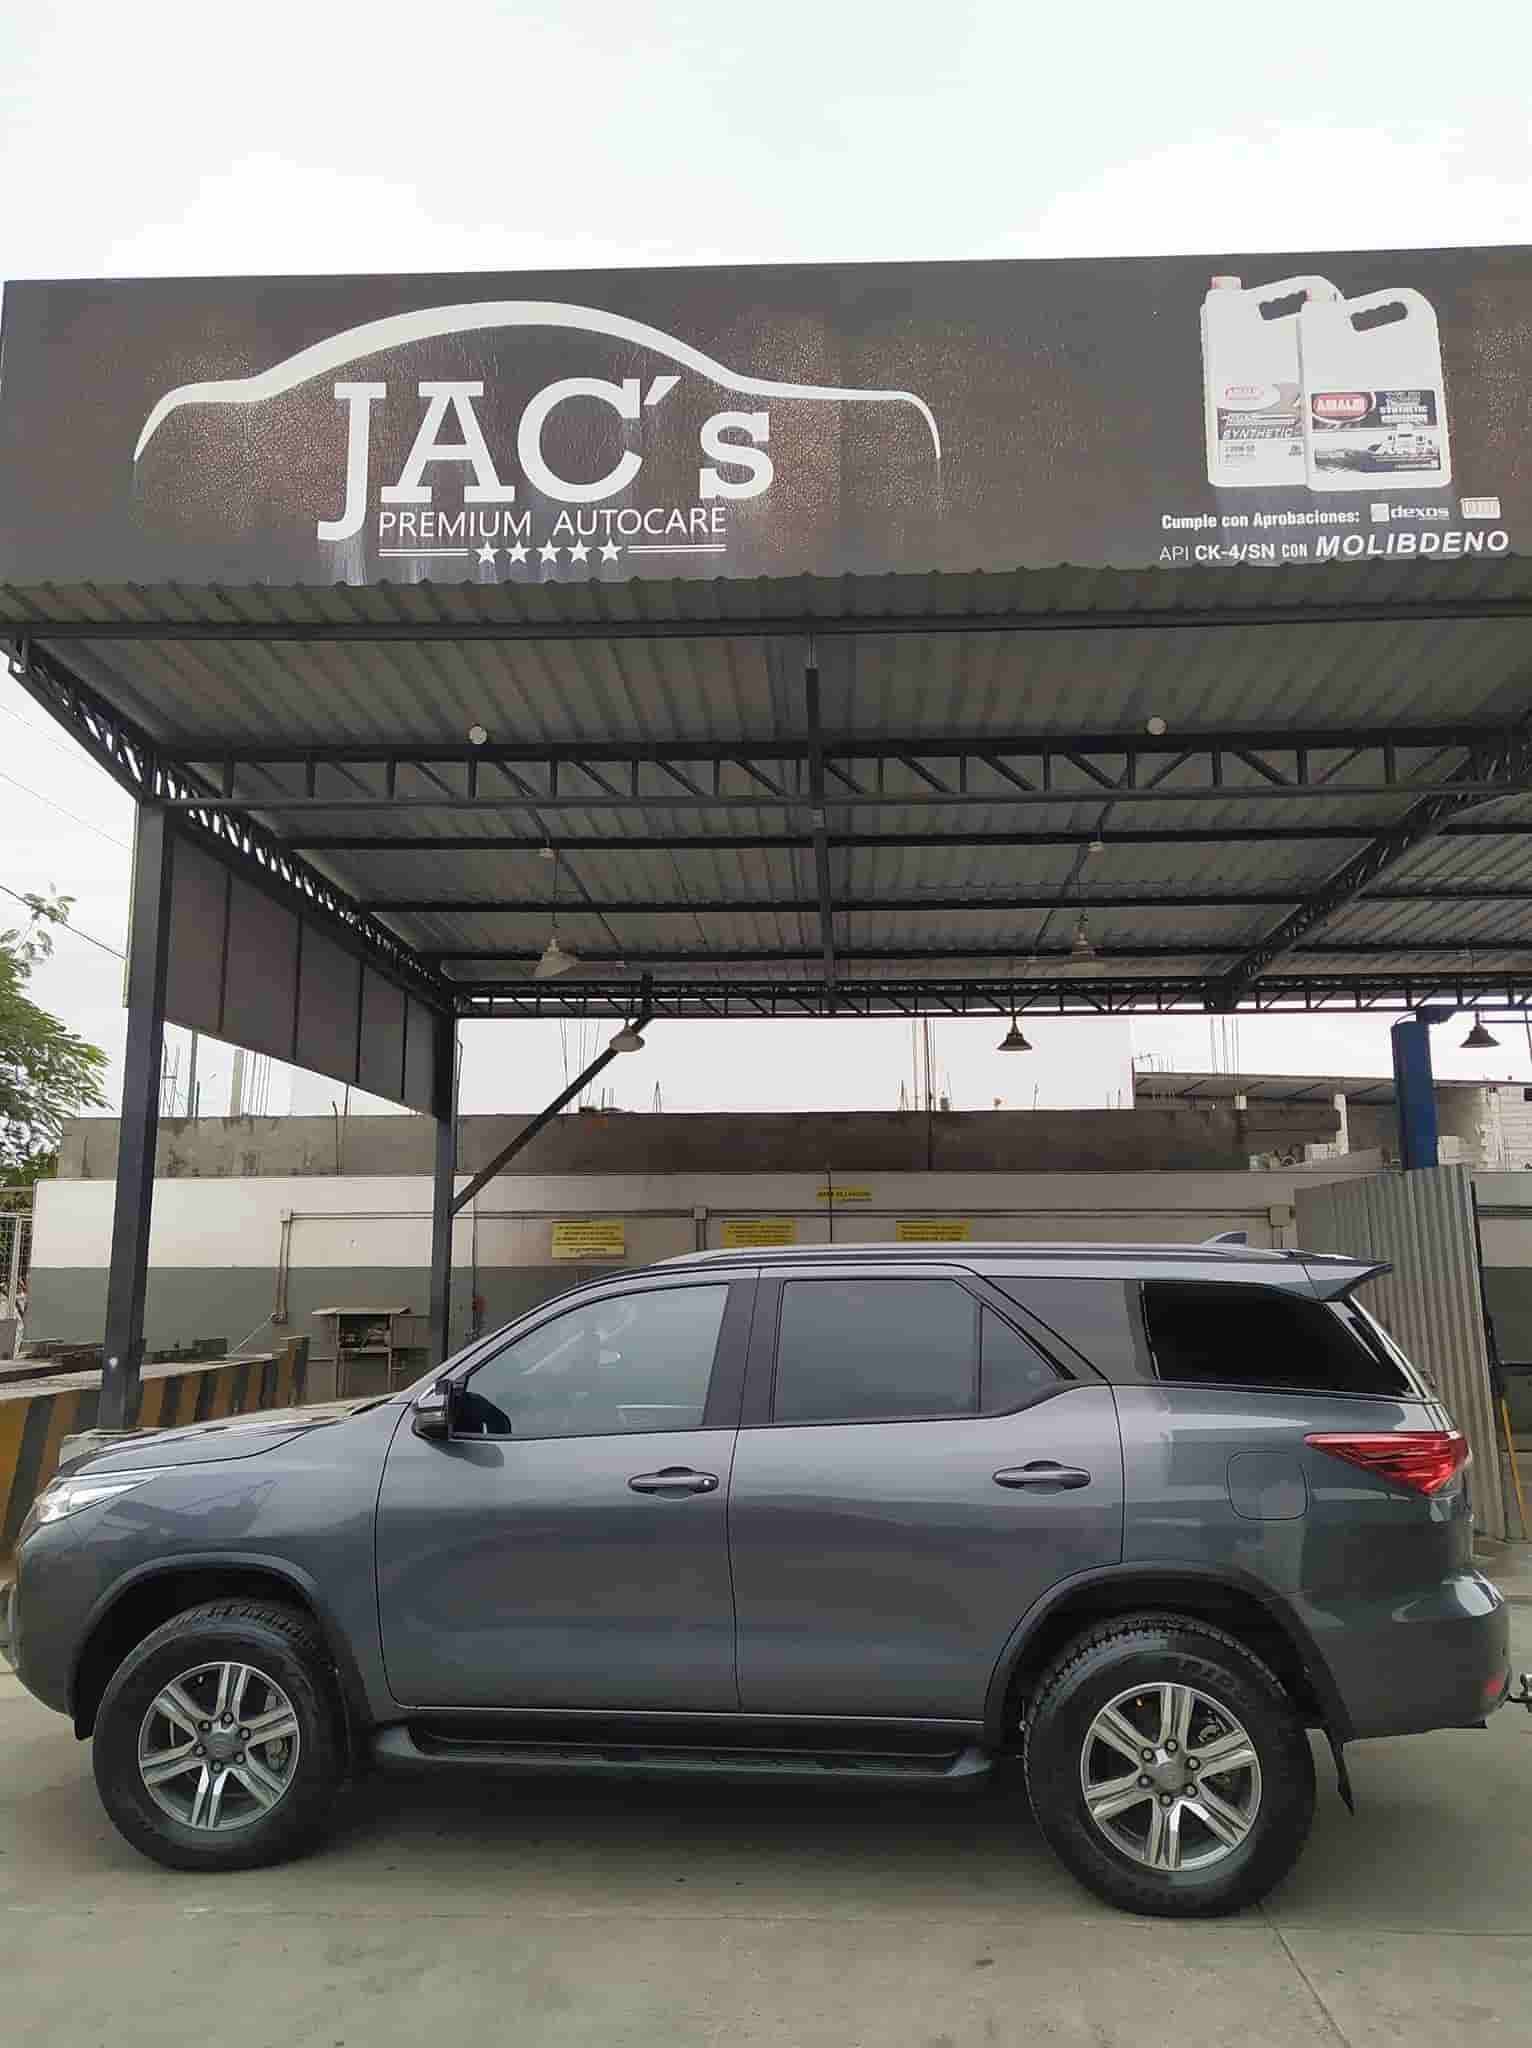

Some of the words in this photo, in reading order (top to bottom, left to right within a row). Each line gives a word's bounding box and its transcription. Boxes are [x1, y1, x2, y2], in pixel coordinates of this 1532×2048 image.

[317, 376, 775, 542] JAC's
[379, 511, 531, 538] PREMIUM
[552, 507, 727, 536] AUTOCARE
[1161, 513, 1217, 532] Cumple
[1221, 515, 1249, 528] con
[1252, 508, 1361, 529] Aprobaciones:
[1390, 504, 1450, 520] dexos
[1159, 545, 1189, 561] API
[1194, 543, 1275, 561] CK-4/SN
[1315, 530, 1509, 558] MOLIBDENO
